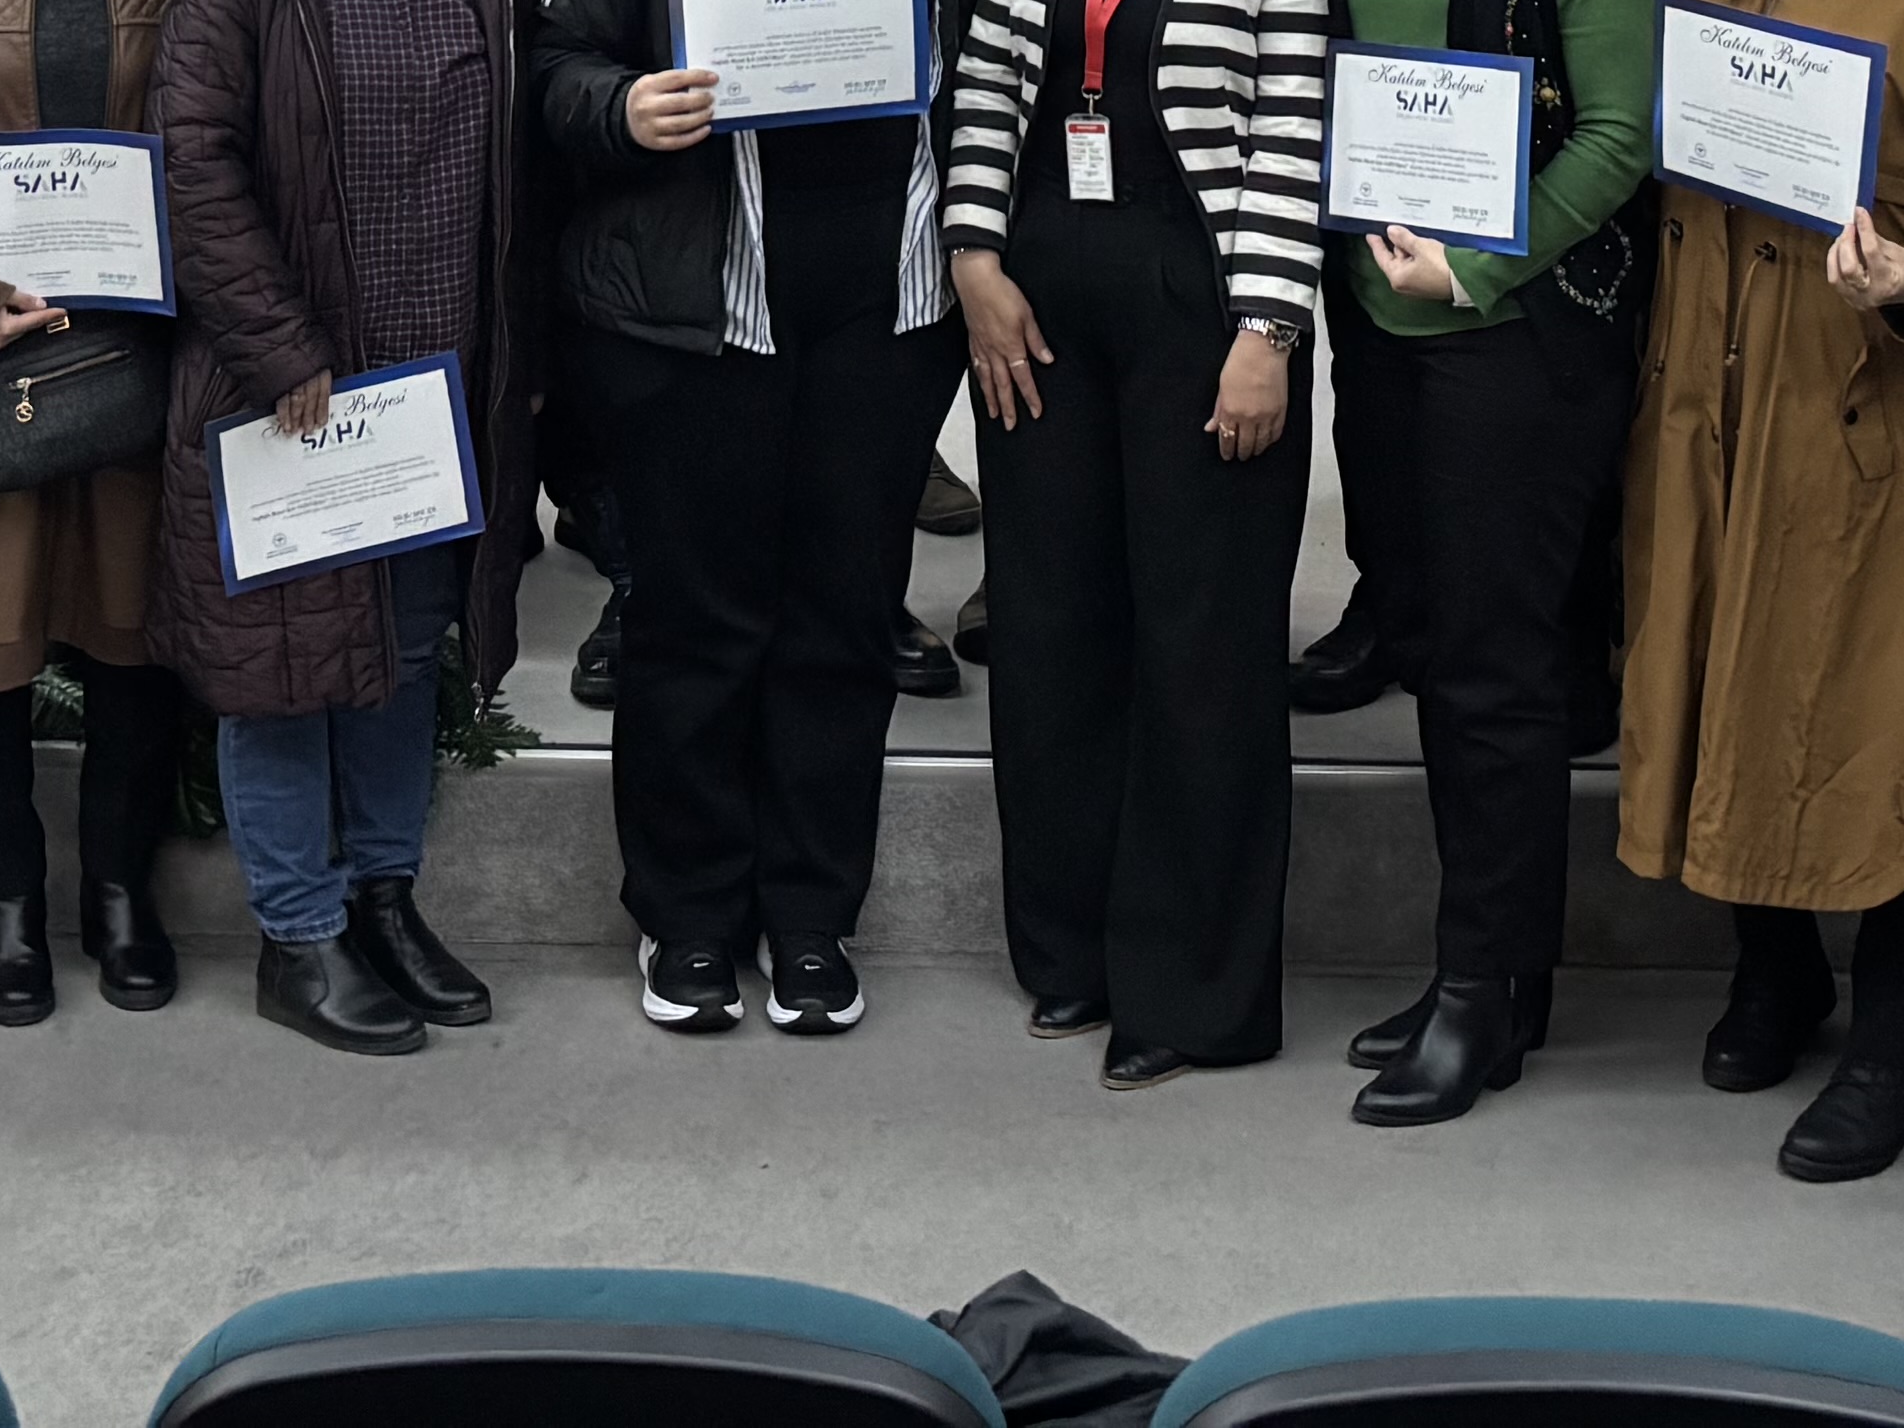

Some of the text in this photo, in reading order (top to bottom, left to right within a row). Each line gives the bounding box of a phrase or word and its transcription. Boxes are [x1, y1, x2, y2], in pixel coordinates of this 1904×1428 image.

[1730, 55, 1793, 93] SAHA
[1396, 89, 1453, 116] SAHA
[14, 171, 88, 194] SAHA
[301, 418, 374, 451] SAHA
